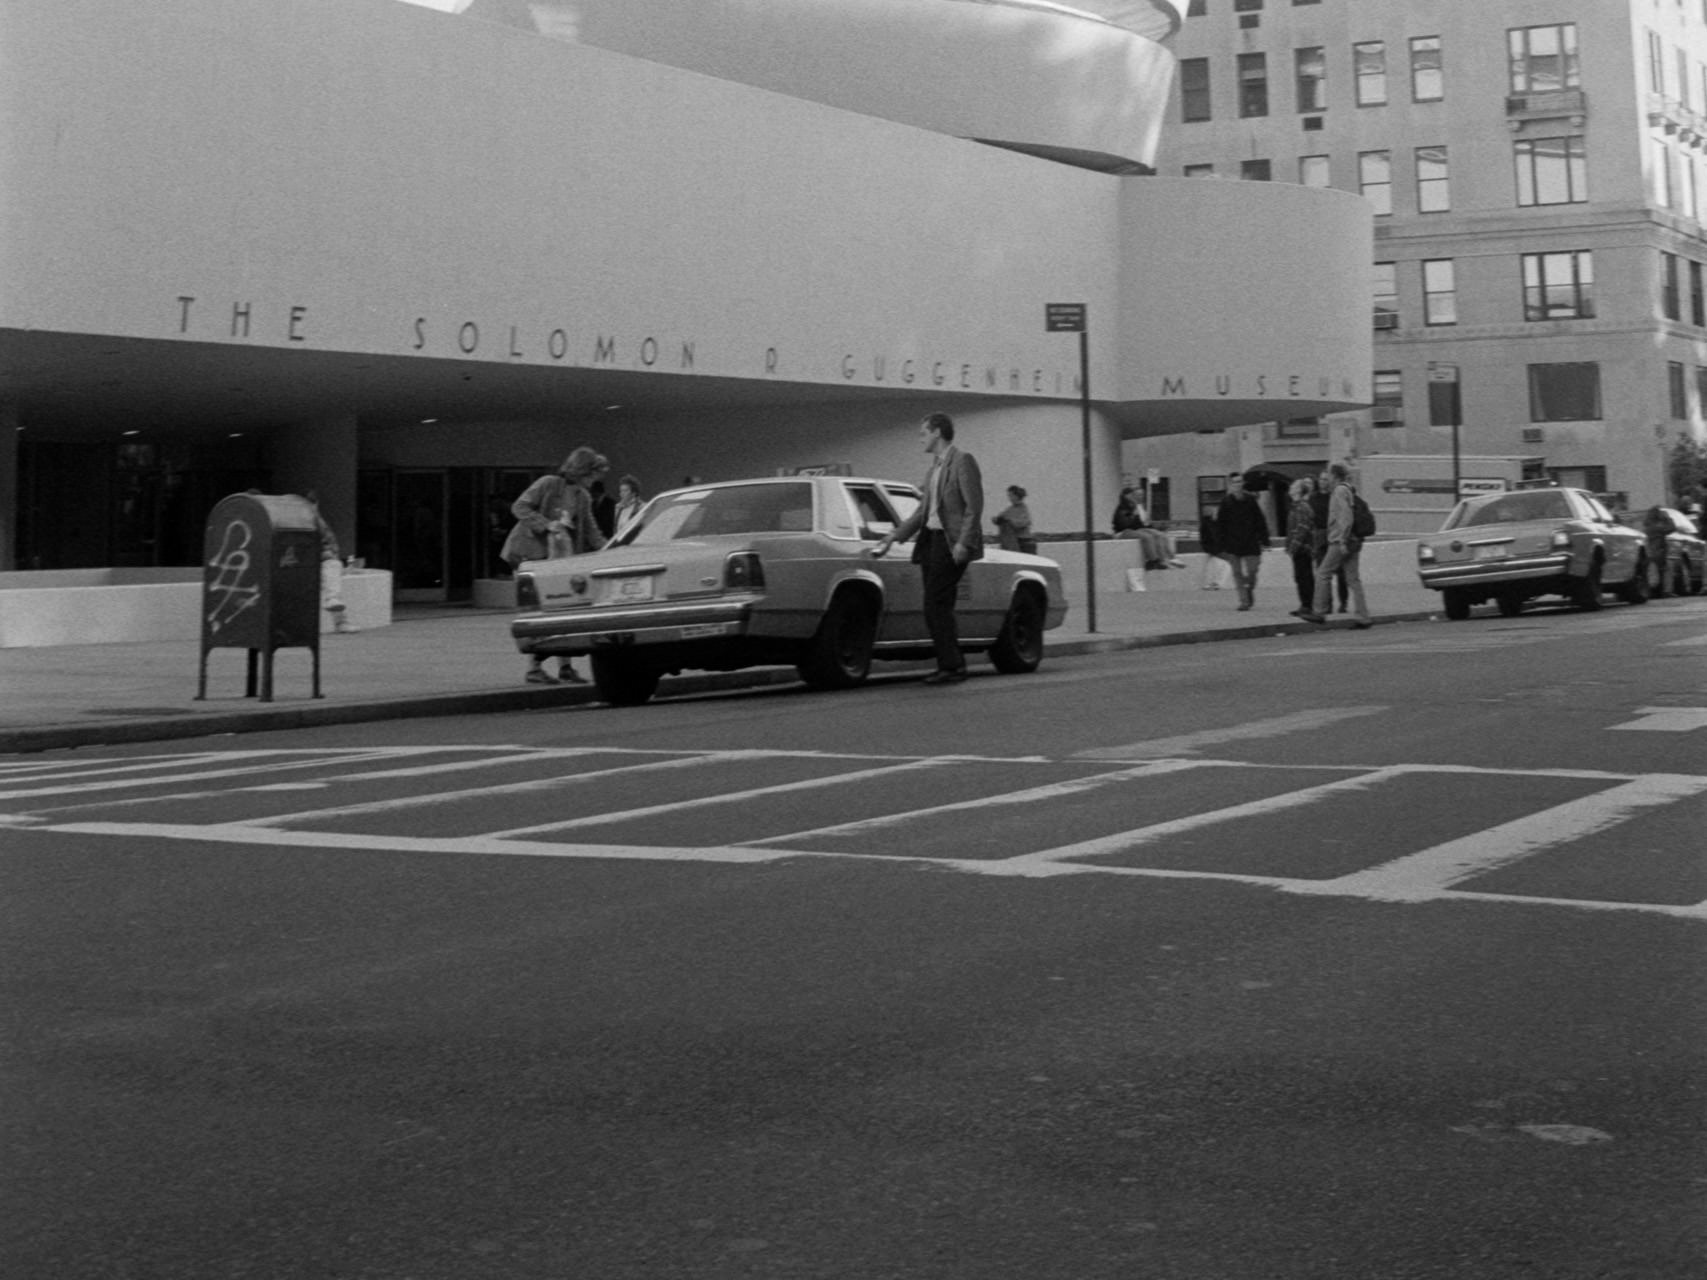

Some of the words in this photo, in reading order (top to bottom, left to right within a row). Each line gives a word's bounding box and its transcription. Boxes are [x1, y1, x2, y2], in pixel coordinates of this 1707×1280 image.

[177, 296, 307, 341] THE
[413, 317, 696, 368] SOLOMON
[765, 347, 779, 373] R
